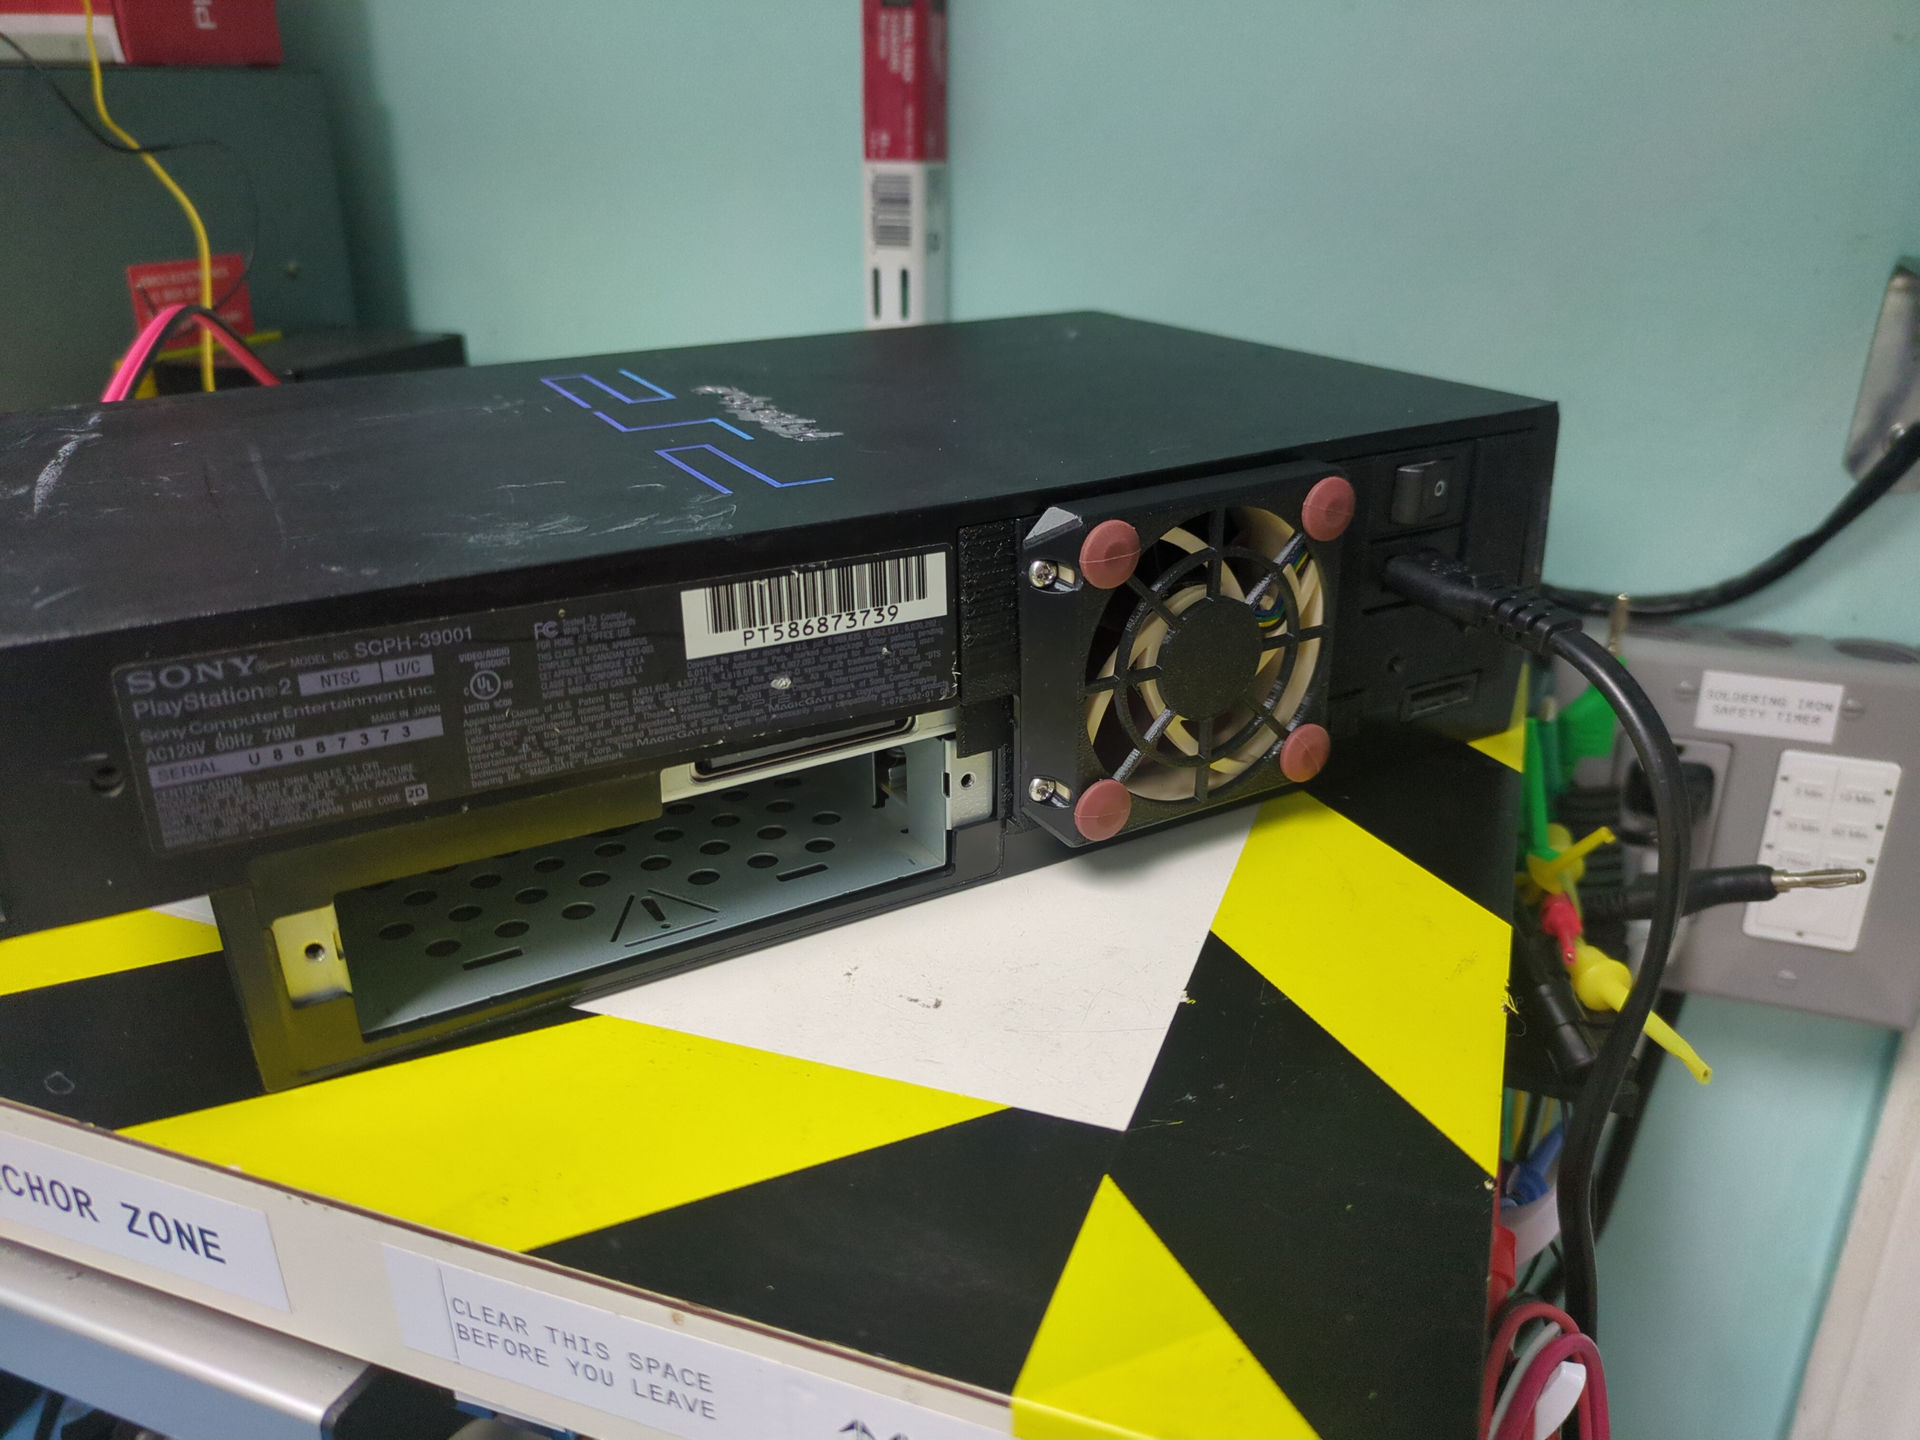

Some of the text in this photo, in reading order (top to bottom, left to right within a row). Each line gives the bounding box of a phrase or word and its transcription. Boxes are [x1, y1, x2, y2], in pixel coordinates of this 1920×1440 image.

[743, 605, 899, 647] PT586873739
[354, 626, 473, 658] SCPH-39001
[554, 636, 574, 647] HOME
[459, 646, 510, 662] VIDEO/AUDIO
[395, 661, 421, 676] U/C
[474, 657, 511, 670] PRODUCT
[635, 665, 643, 673] LA
[321, 671, 360, 688] NTSC
[611, 675, 637, 686] CANADA
[464, 702, 490, 713] LISTED
[578, 695, 603, 705] Patent
[611, 700, 628, 709] from
[139, 682, 435, 746] Sony Computer Entertainment Inc.
[371, 704, 440, 723] MADE IN JAPAN
[144, 739, 208, 763] AC120V
[215, 731, 255, 750] 60Hz
[157, 760, 218, 782] SERIAL
[0, 1163, 228, 1266] CHOR ZONE
[452, 1296, 715, 1394] CLEAR THIS SPACE
[456, 1321, 718, 1421] BEFORE YOU LEAVE
